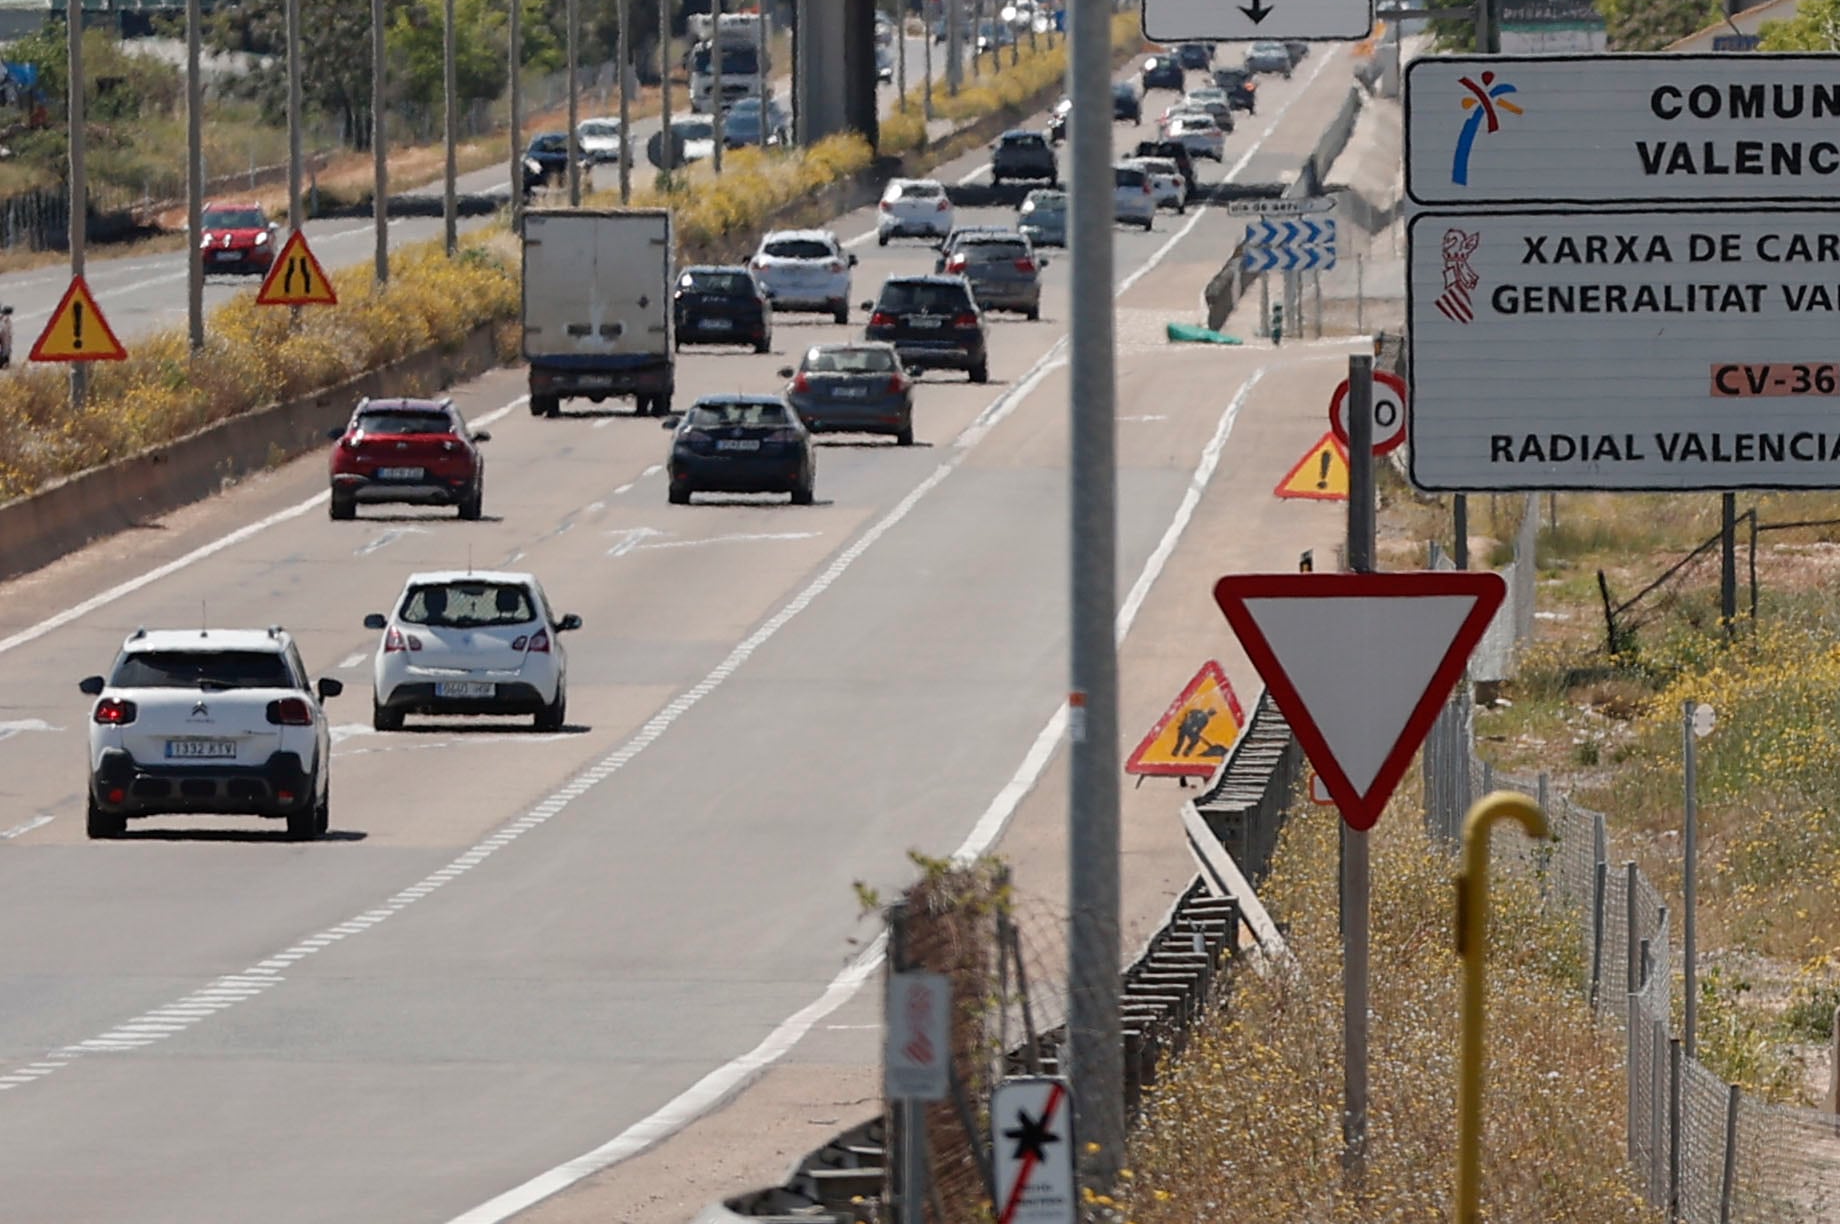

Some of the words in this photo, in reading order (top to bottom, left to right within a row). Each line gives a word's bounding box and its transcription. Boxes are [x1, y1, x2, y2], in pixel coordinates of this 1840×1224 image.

[1521, 234, 1674, 265] XARXA
[1688, 233, 1743, 263] DE
[1490, 282, 1768, 316] GENERALITAT
[1714, 364, 1837, 396] CV-36
[1489, 432, 1645, 464] RADIAL
